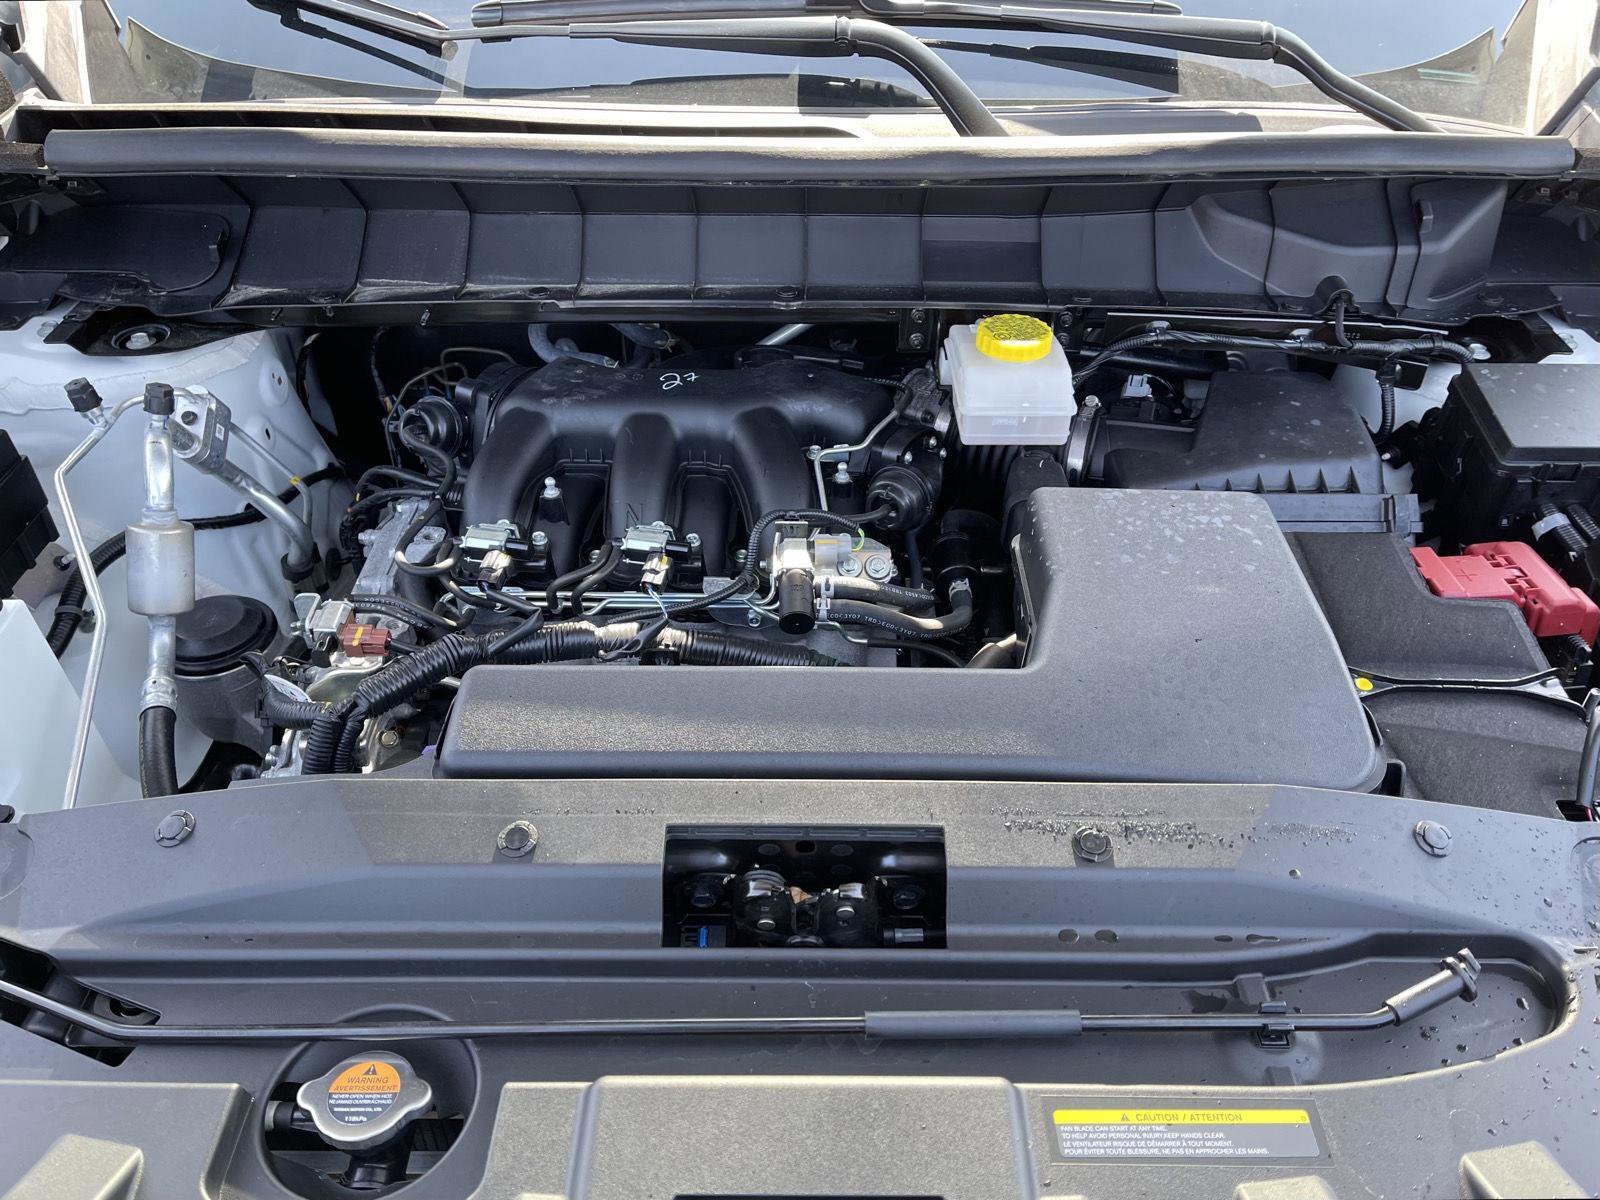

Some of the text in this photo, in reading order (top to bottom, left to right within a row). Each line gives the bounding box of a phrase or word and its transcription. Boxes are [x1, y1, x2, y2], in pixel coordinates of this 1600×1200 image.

[660, 372, 700, 389] 27
[1135, 1113, 1179, 1122] CAUTION
[1190, 1113, 1243, 1122] ATTENTION
[1084, 1147, 1106, 1155] ÉVITER
